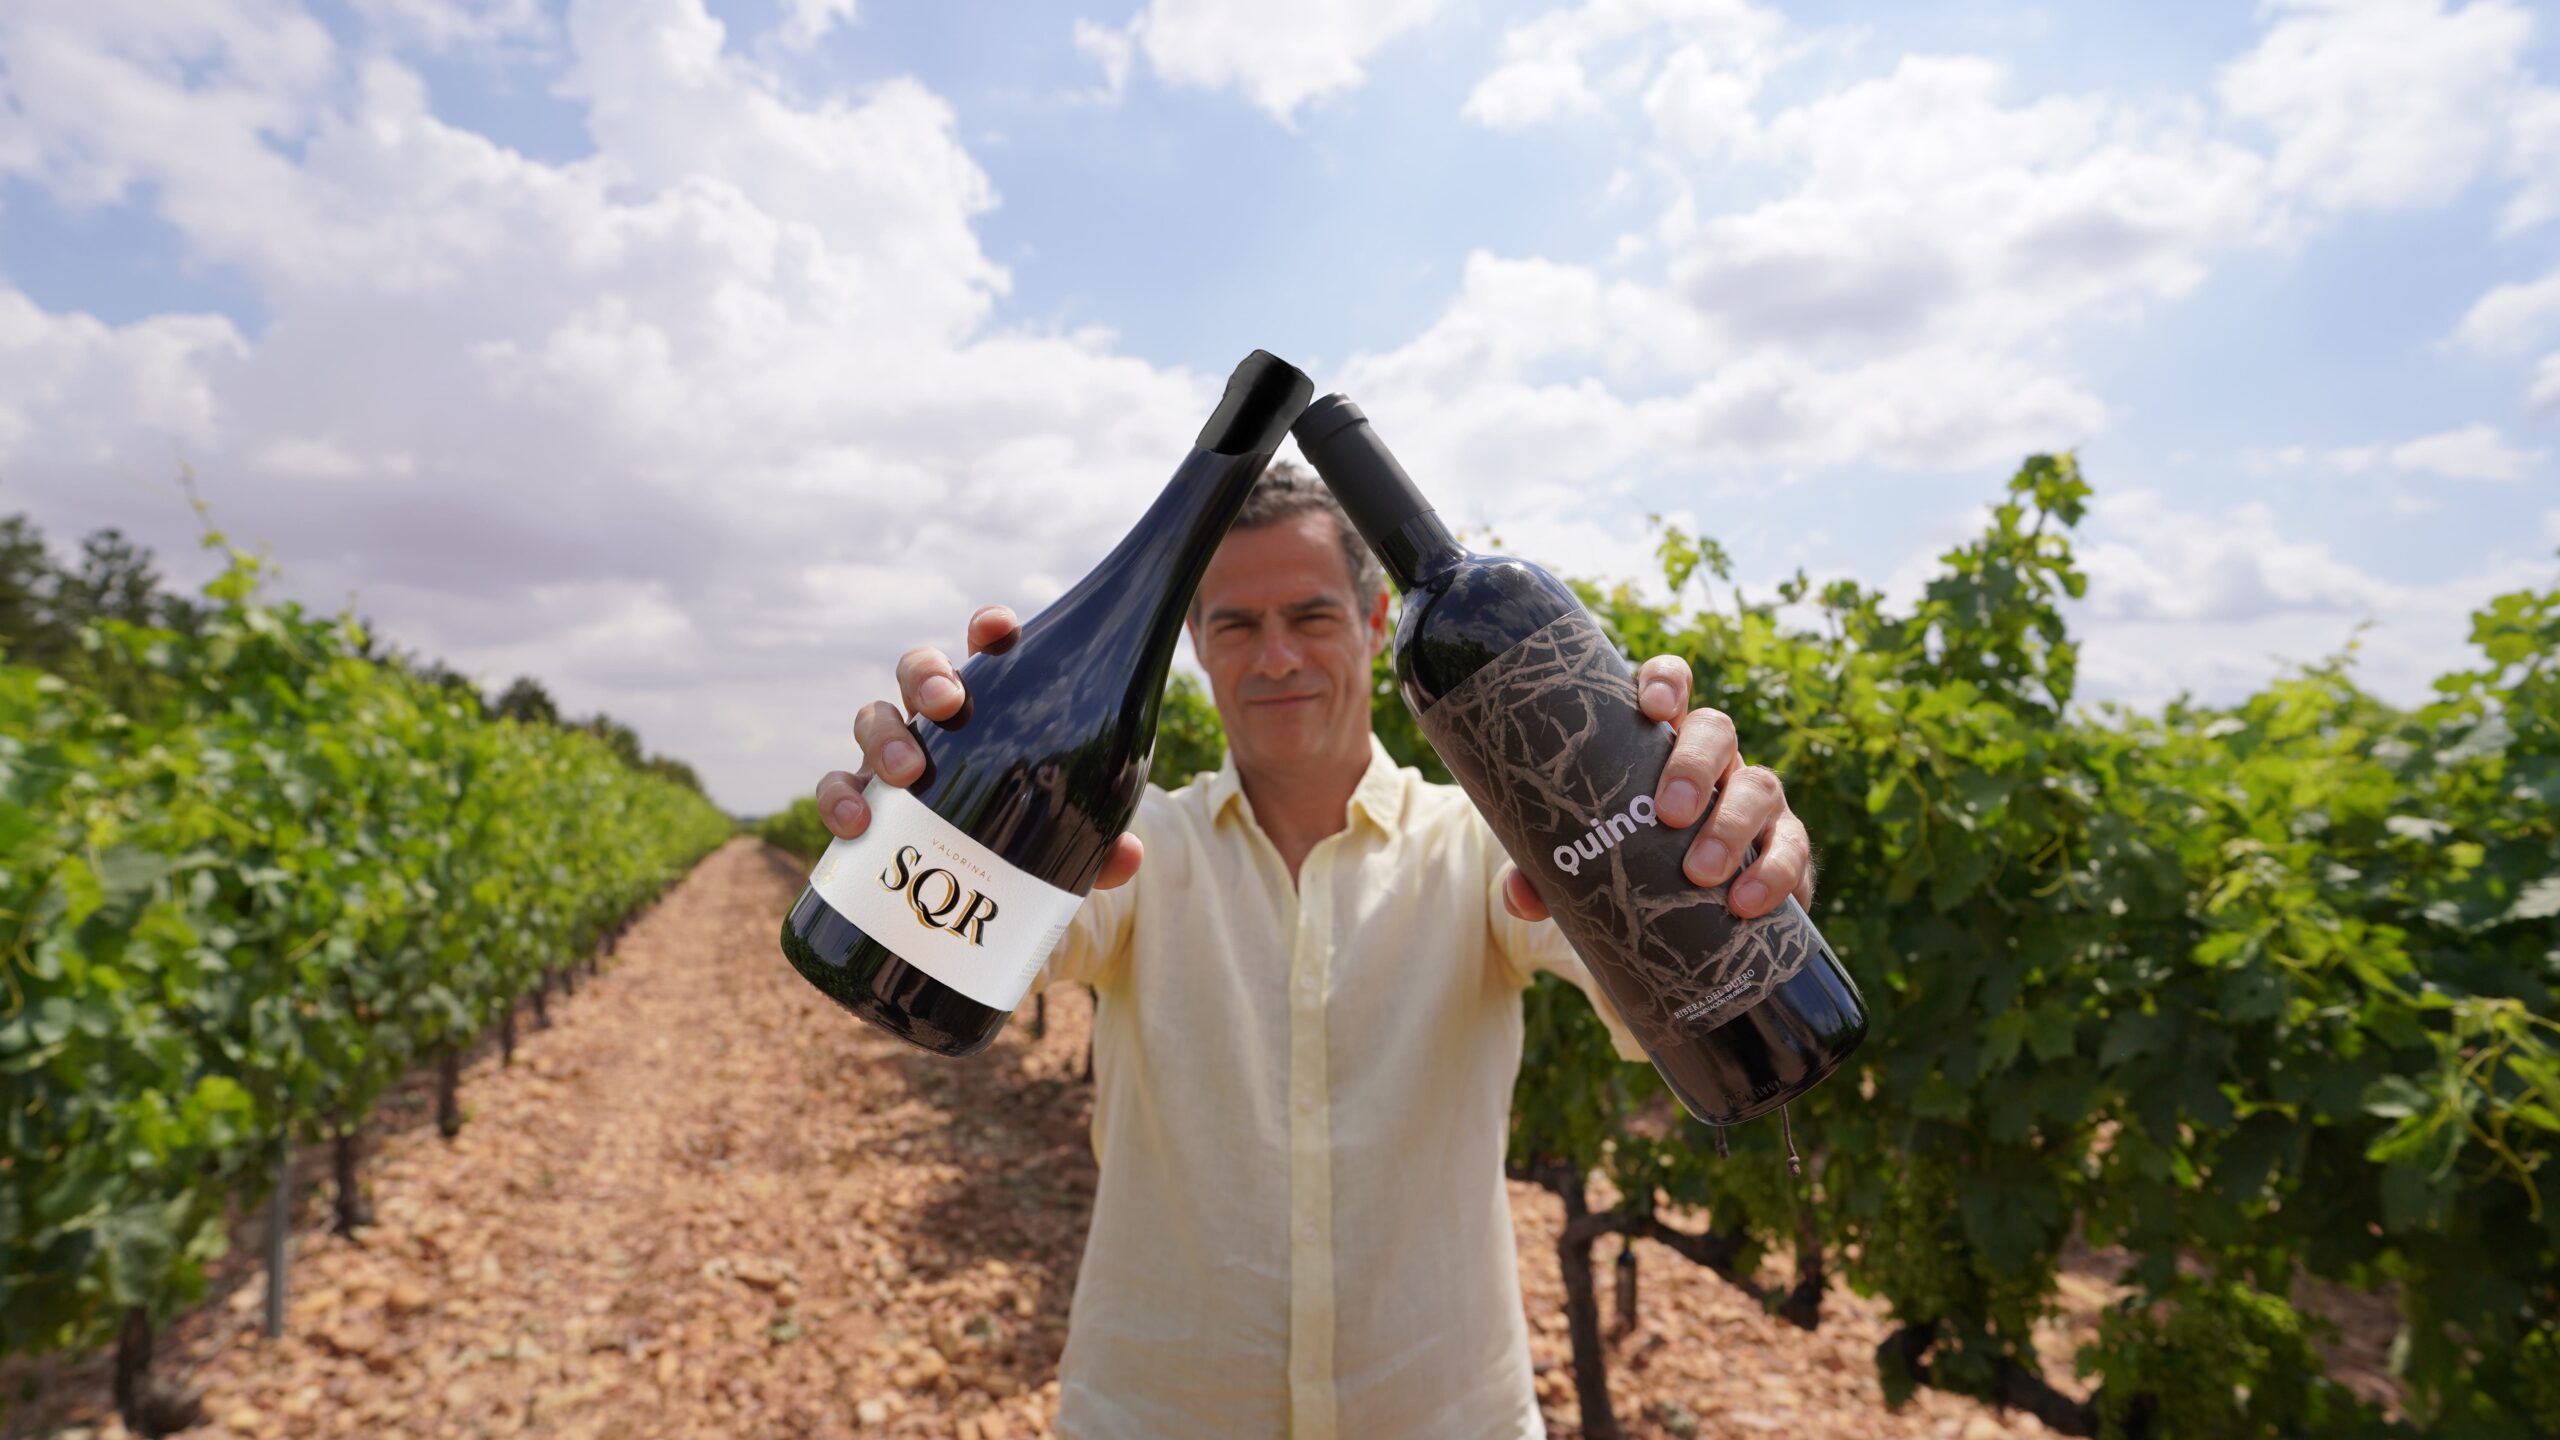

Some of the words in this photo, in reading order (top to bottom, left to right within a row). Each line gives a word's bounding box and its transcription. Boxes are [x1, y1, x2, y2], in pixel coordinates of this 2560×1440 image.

[932, 837, 992, 883] VALDRINAL
[874, 845, 999, 948] SQR
[1674, 1000, 1705, 1019] RIBERA
[1705, 988, 1725, 1004] DEL
[1724, 969, 1755, 993] DUERO
